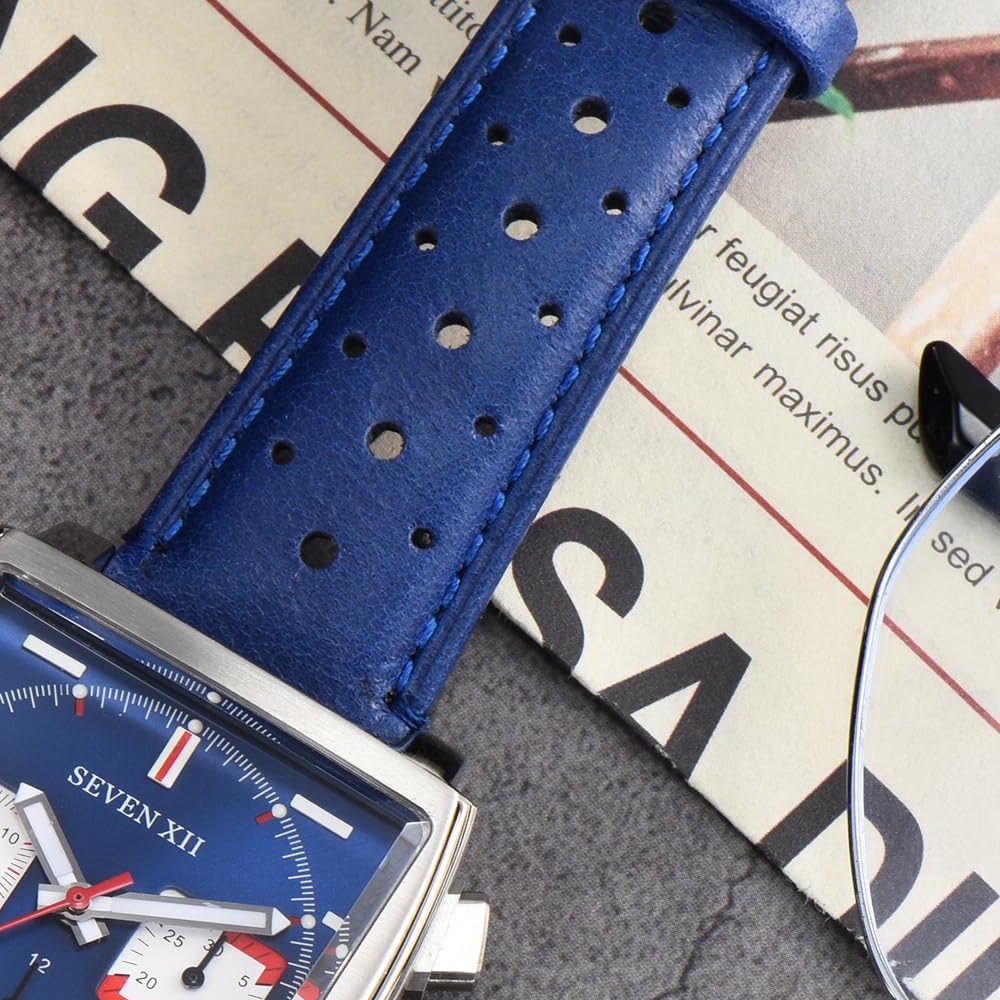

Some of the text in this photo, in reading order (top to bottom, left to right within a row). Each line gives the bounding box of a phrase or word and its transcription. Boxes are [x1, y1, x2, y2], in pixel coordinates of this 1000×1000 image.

[345, 0, 421, 76] Nam
[715, 237, 820, 336] feugiat
[815, 332, 888, 402] risus
[753, 362, 883, 494] maximus.
[931, 531, 995, 587] sed
[67, 766, 206, 857] SEVEN XII
[1, 828, 20, 845] 10
[163, 929, 186, 948] 25
[203, 939, 224, 957] 30
[29, 953, 51, 974] 12
[136, 971, 158, 990] 20
[238, 975, 250, 988] 5
